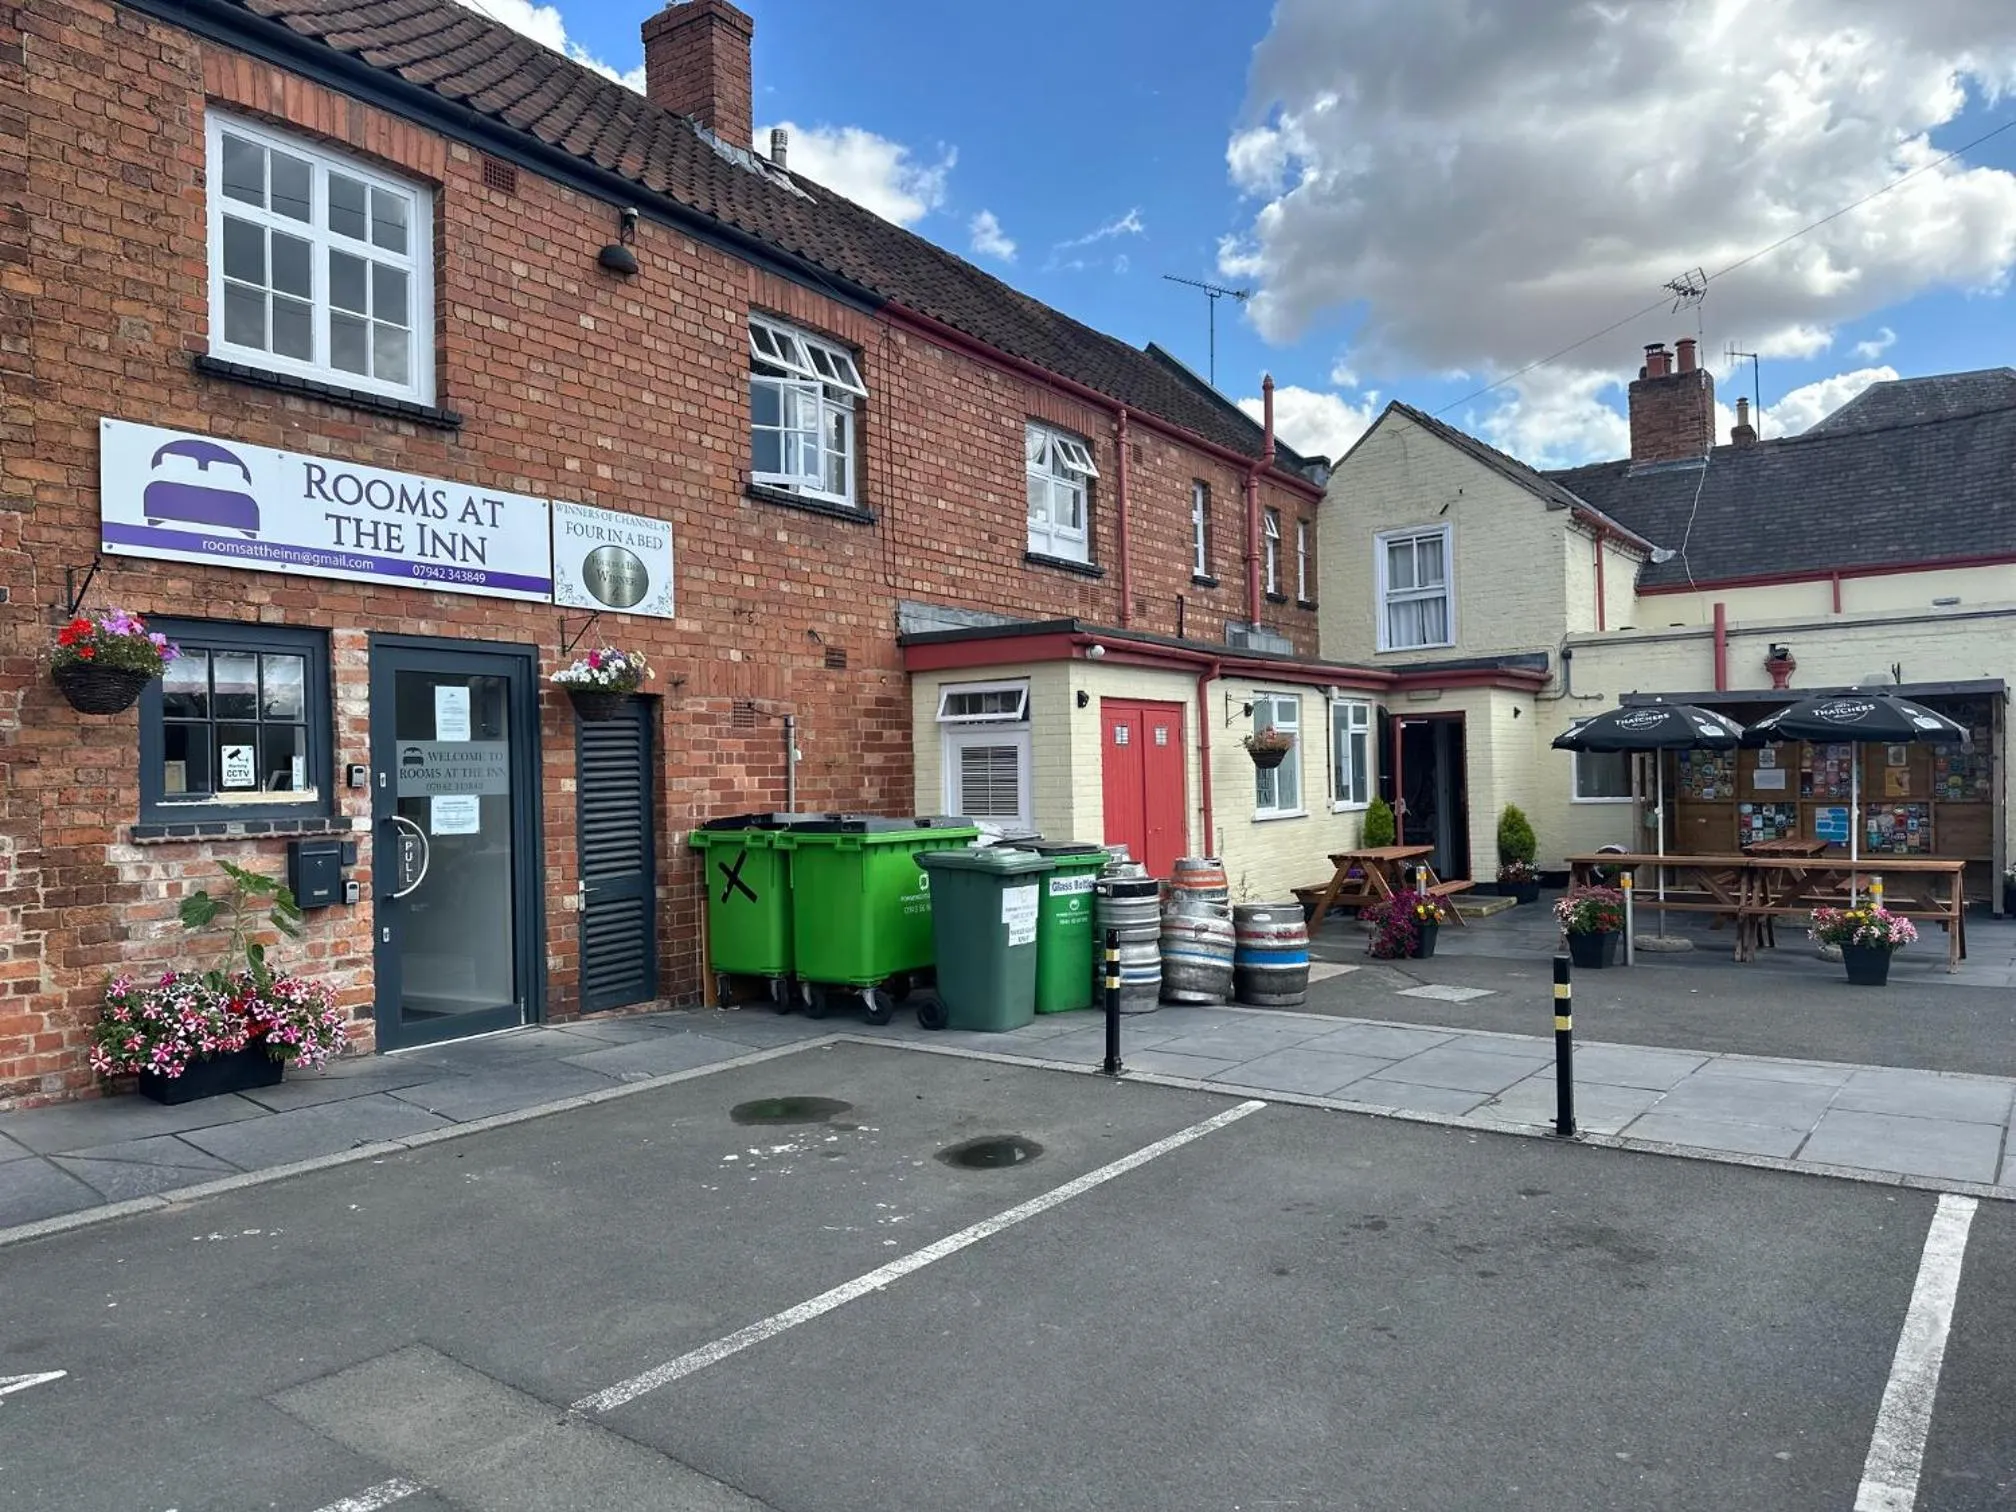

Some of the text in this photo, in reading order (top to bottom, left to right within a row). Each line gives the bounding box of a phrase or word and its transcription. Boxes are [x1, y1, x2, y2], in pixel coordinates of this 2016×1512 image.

[303, 462, 504, 528] ROOMS AT
[556, 503, 600, 519] WINNERS
[601, 511, 612, 524] OF
[615, 514, 657, 530] CHANNEL
[325, 512, 487, 565] THE INN
[566, 521, 663, 550] FOUR IN A BED
[202, 538, 374, 570] roomsattheinn@gmail.com
[412, 565, 486, 583] 07942 343849
[1811, 703, 1876, 716] THATCHERS
[1614, 713, 1670, 726] THATCHERS
[427, 751, 503, 762] WELCOME TO
[227, 769, 249, 777] CCTV
[400, 768, 441, 779] ROOMS
[444, 768, 459, 778] AT
[460, 768, 484, 778] THE
[405, 841, 414, 883] PULL
[1052, 880, 1073, 892] Glass
